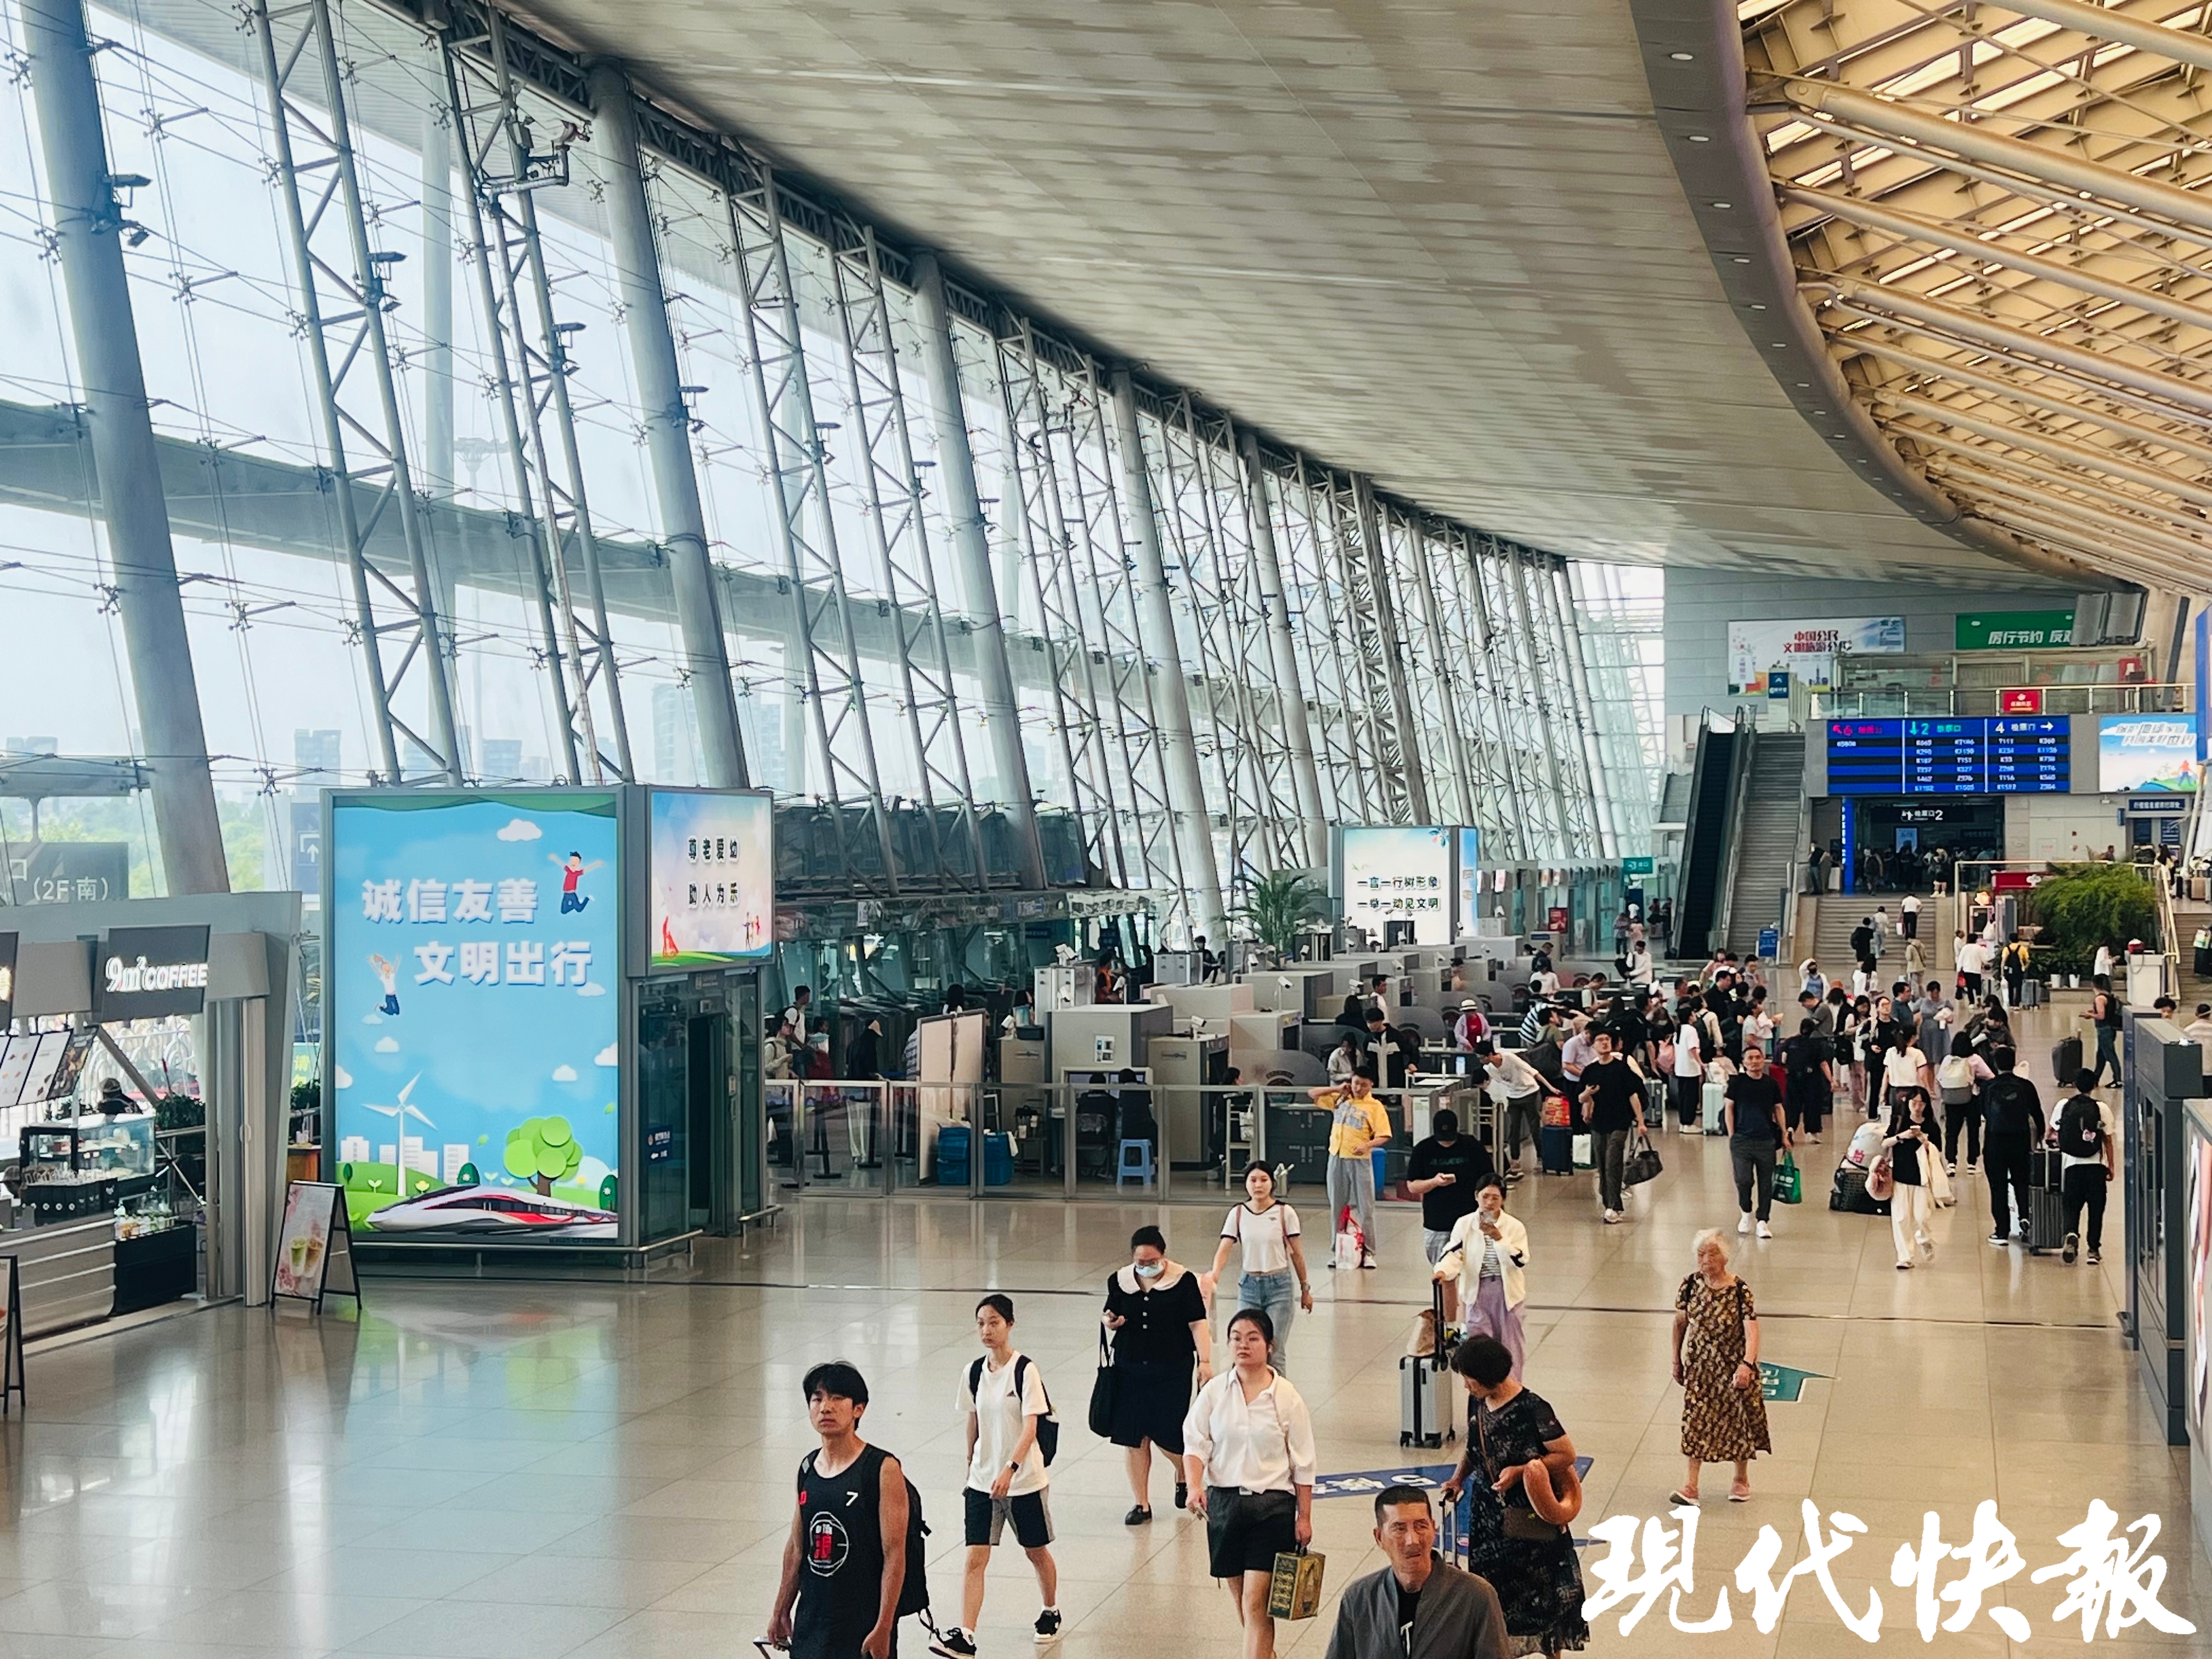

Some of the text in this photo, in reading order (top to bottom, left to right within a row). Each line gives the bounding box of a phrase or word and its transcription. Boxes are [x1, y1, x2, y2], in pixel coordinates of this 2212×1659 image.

[1988, 631, 2044, 645] 厉行节约
[1921, 723, 1929, 736] 2
[1995, 721, 2005, 733] 4
[688, 837, 738, 860] 尊老爱幼
[1357, 876, 1438, 889] 一言一行树形象
[688, 882, 738, 905] 助人为乐
[362, 879, 539, 923] 诚信友善
[1357, 898, 1438, 910] 一举一动见文明
[413, 940, 593, 986] 文明出行
[845, 1491, 859, 1506] 7
